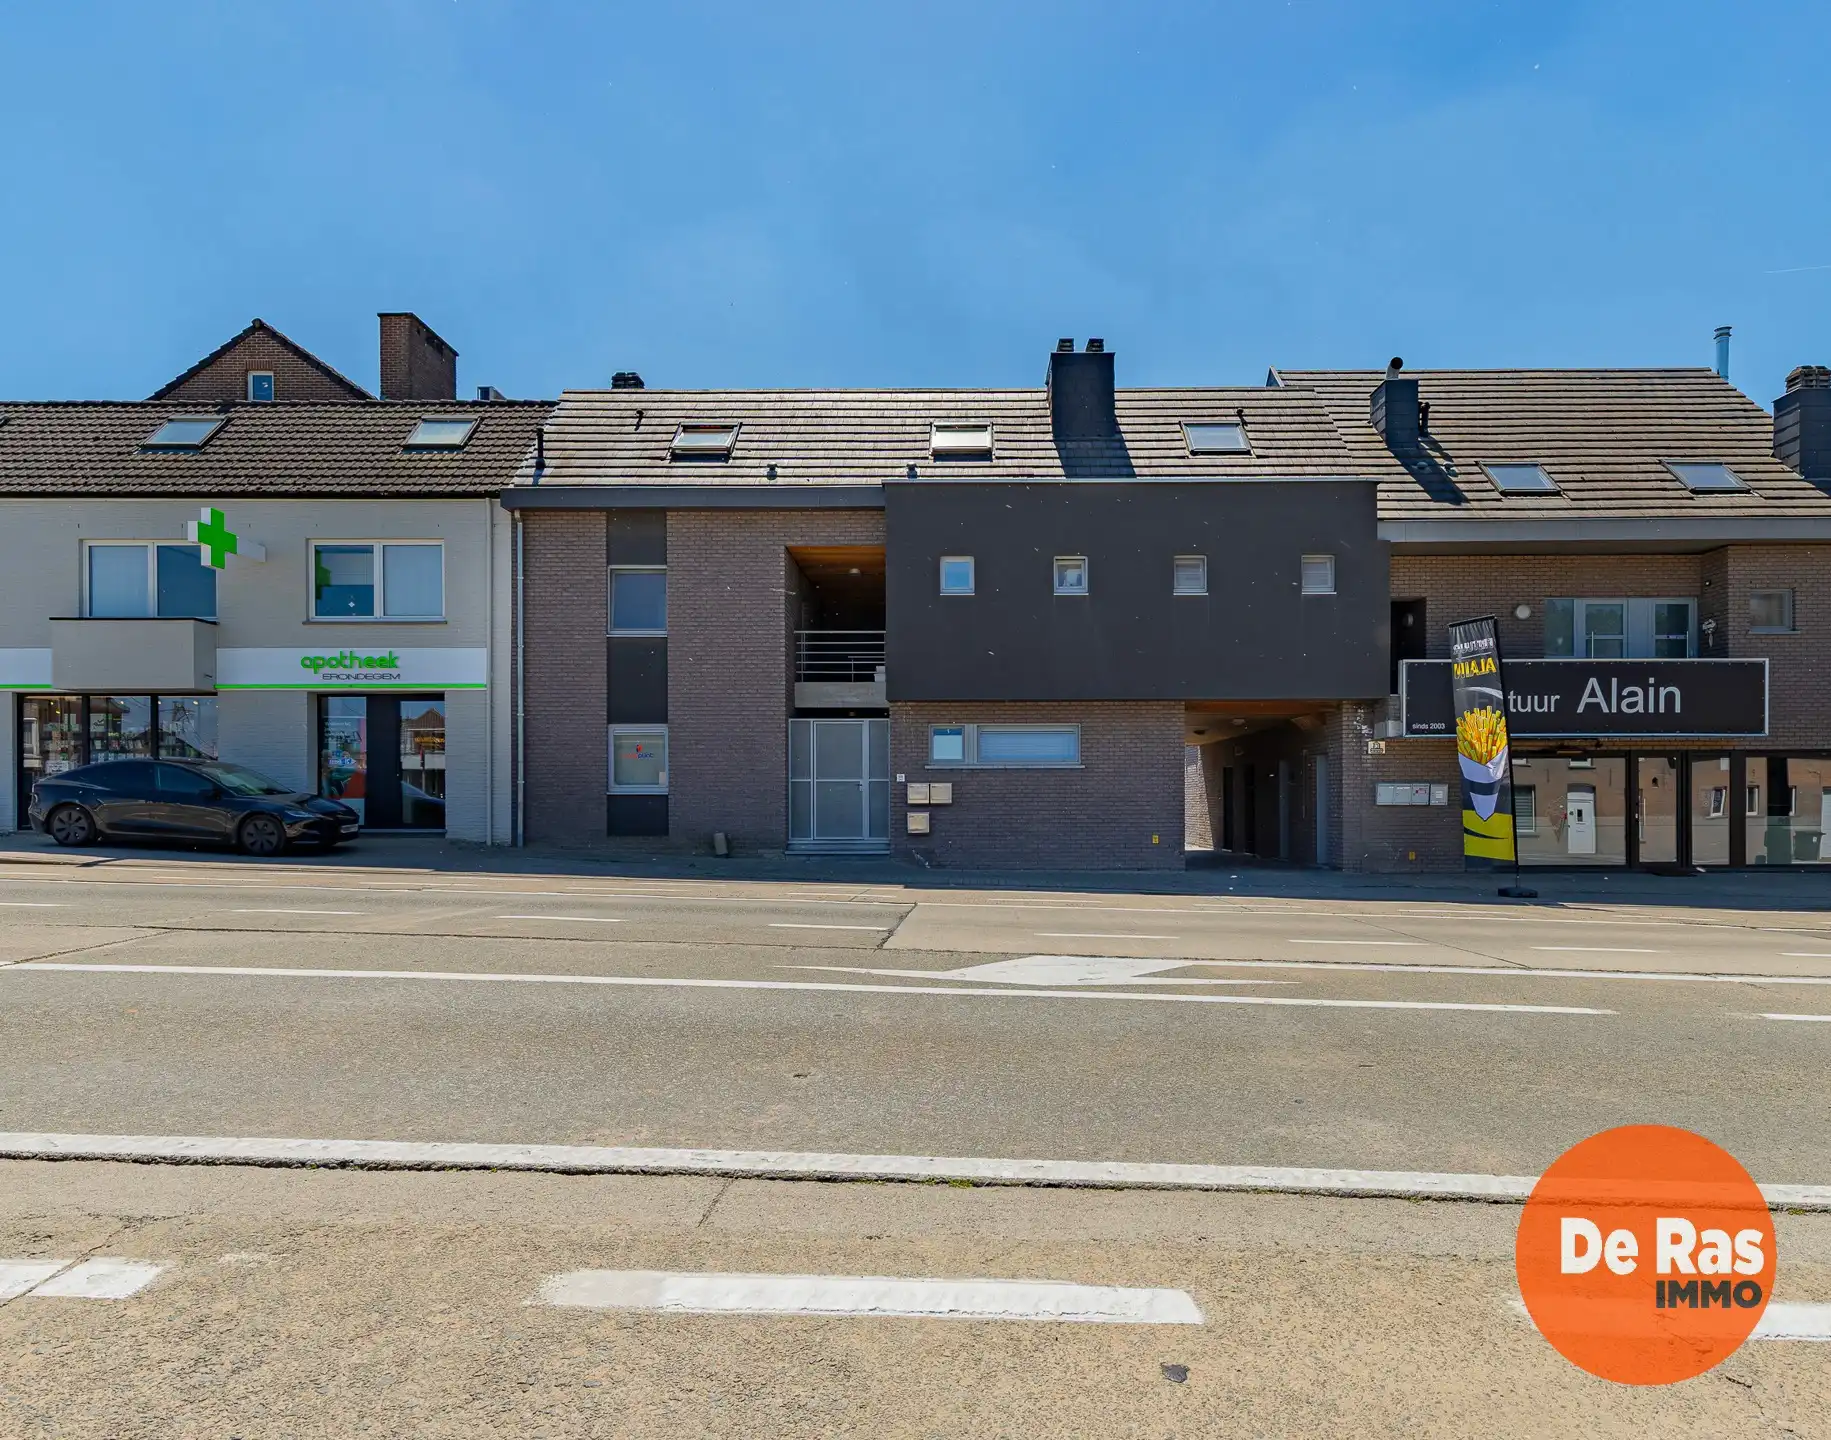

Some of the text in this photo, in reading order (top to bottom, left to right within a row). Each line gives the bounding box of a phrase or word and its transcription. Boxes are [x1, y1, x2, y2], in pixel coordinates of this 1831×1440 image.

[300, 650, 399, 674] apotheek
[1508, 677, 1681, 714] tuur Alain
[1412, 722, 1446, 730] sinds 2003
